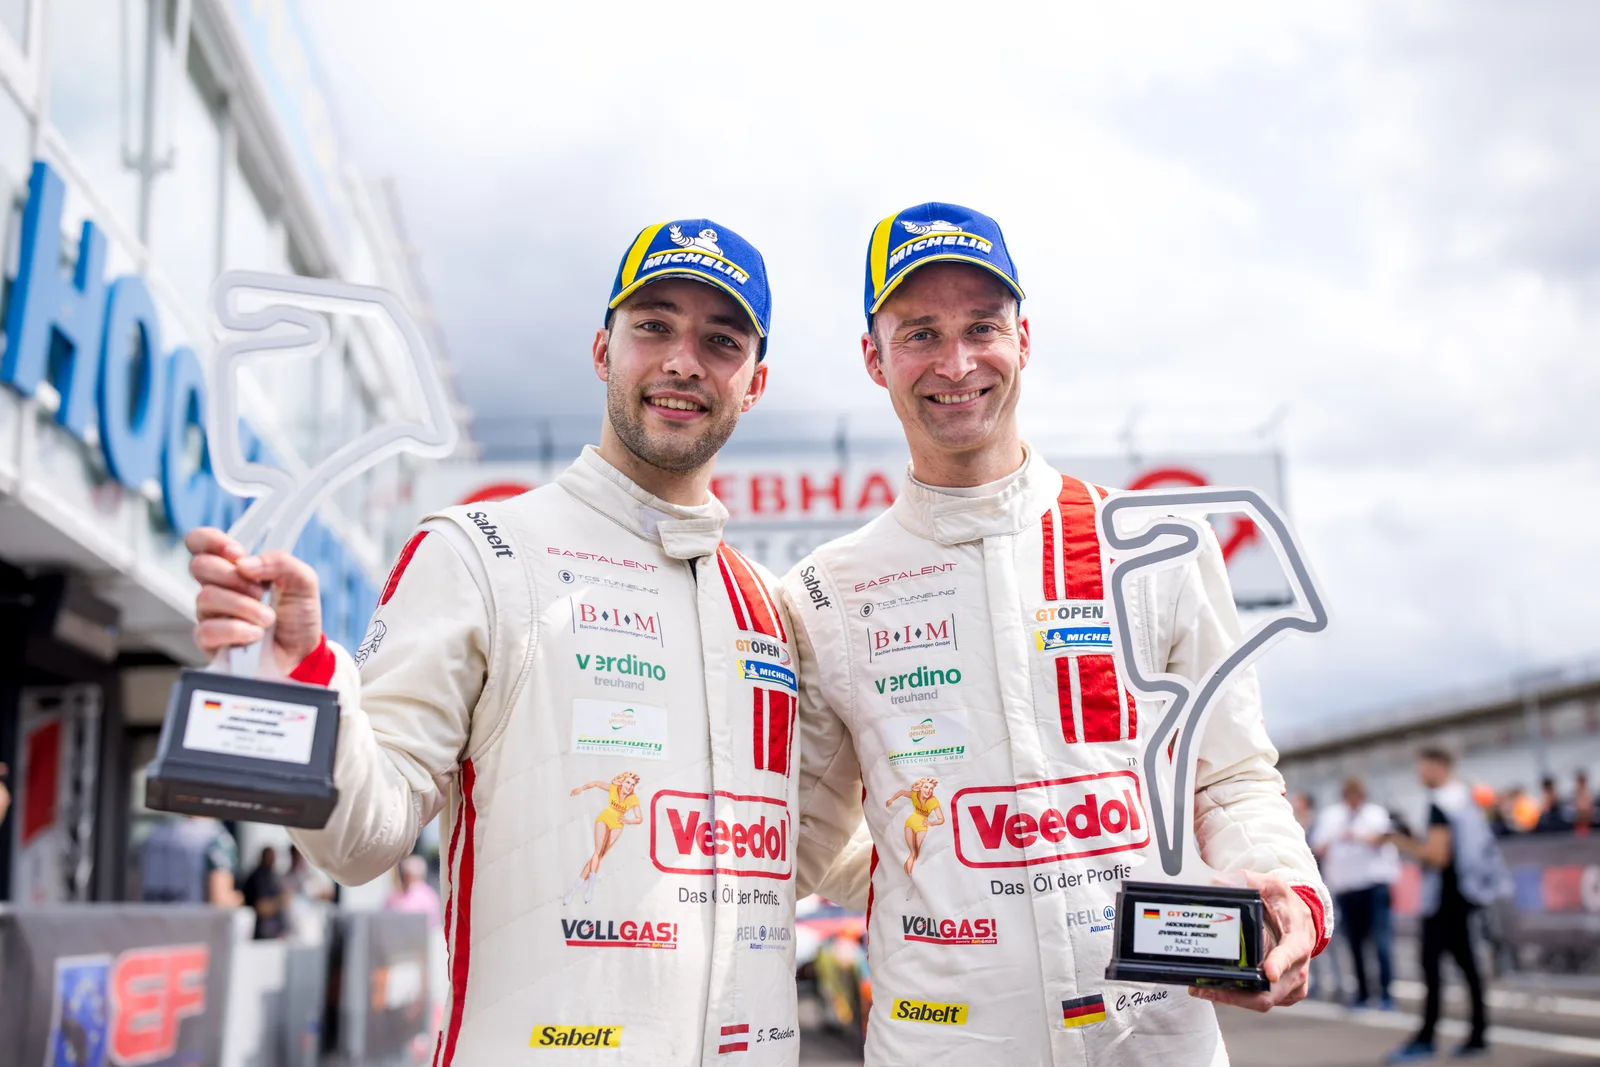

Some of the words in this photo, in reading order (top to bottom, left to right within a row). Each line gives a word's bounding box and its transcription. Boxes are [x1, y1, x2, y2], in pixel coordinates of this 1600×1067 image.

[889, 235, 992, 270] MICHELIN
[642, 252, 748, 286] MICHELIN
[710, 470, 897, 515] EBHA
[466, 511, 514, 558] Sabelt
[547, 547, 659, 573] EASTALENT
[800, 565, 831, 610] Sabelt
[854, 563, 957, 593] EASTALENT
[876, 600, 897, 608] TCS
[899, 588, 956, 602] TUNNELING
[1066, 633, 1113, 642] MICHE
[575, 653, 666, 682] verdino
[759, 668, 794, 684] MICHELIN
[594, 676, 645, 691] treuhand
[874, 666, 962, 695] verdino
[890, 689, 939, 705] treuhand
[968, 789, 1140, 850] Veedol
[990, 880, 1025, 895] Das
[1033, 873, 1053, 892] Öl
[1057, 873, 1083, 889] der
[679, 887, 708, 903] Das
[753, 889, 780, 906] Profis.
[1066, 909, 1102, 927] REIL
[1090, 924, 1111, 933] Allianz
[736, 926, 758, 941] REIL
[1174, 938, 1192, 946] RACE
[896, 1000, 960, 1023] Sabelt
[539, 1026, 613, 1047] Sabelt
[756, 1029, 766, 1043] S.
